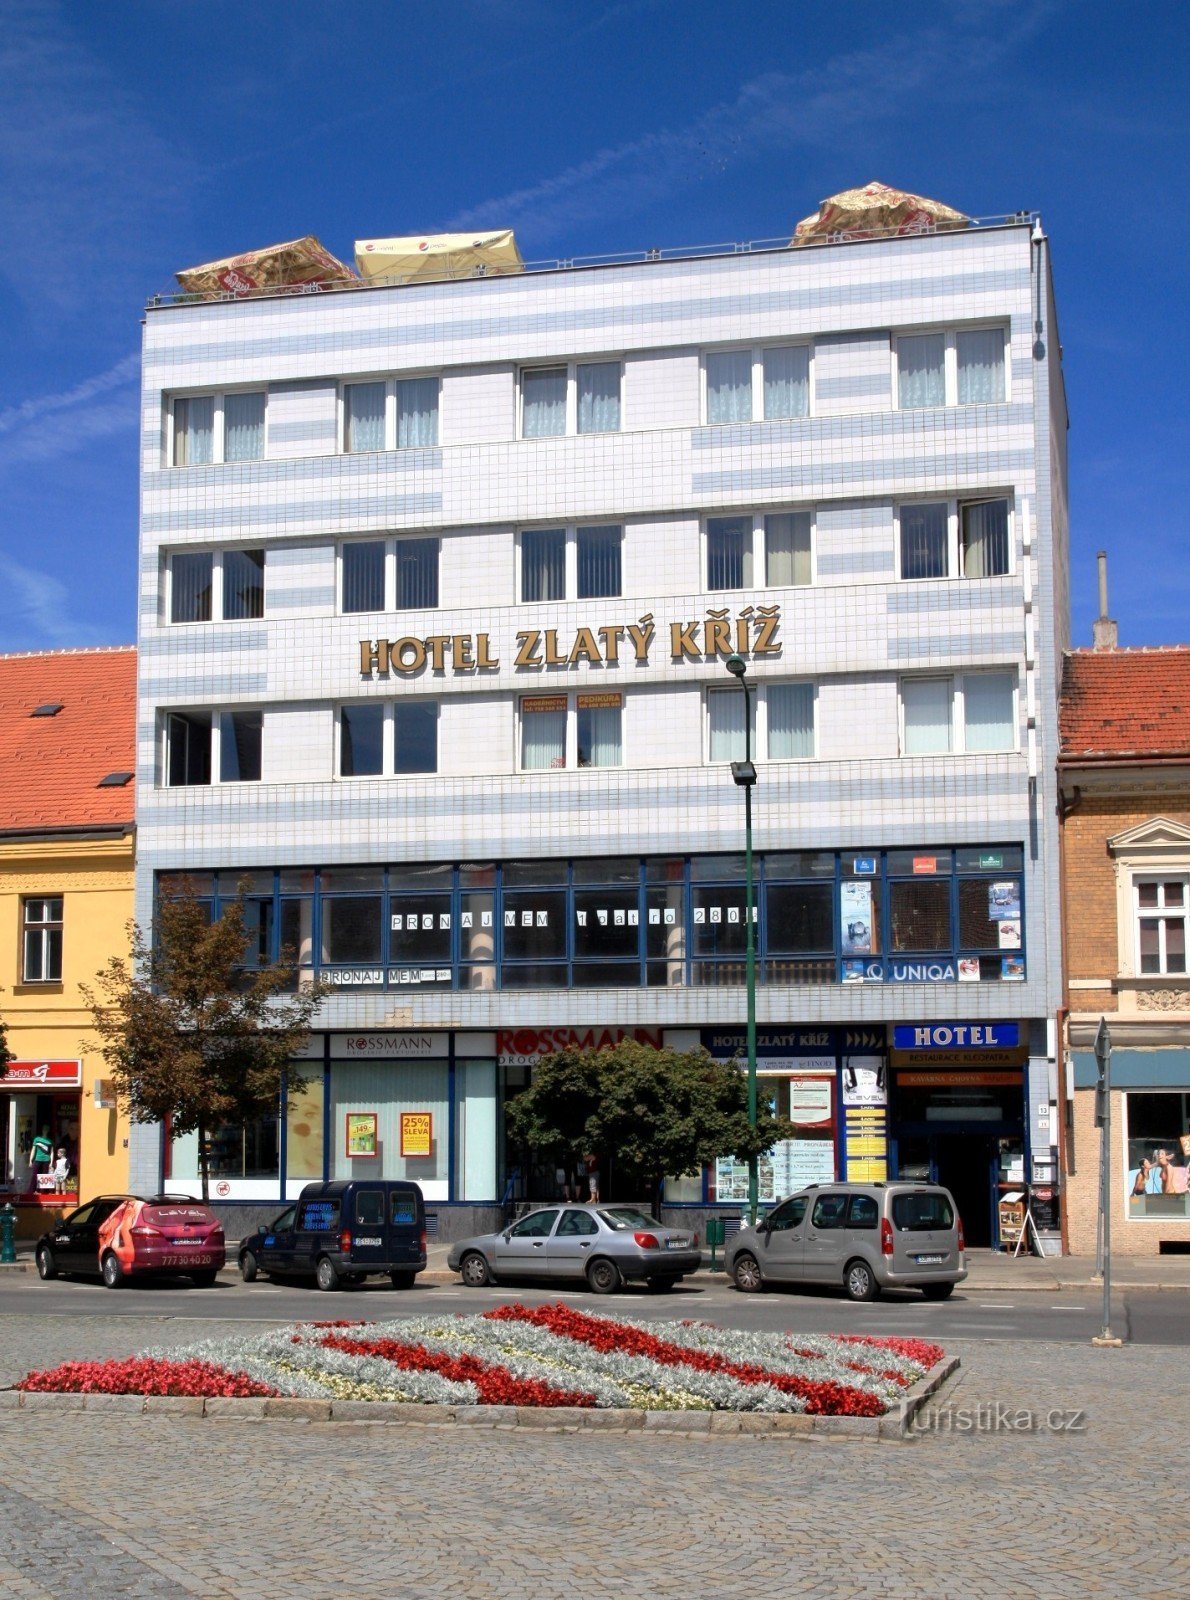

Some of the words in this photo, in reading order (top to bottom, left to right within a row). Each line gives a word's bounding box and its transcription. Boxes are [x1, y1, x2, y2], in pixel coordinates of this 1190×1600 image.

[359, 633, 499, 674] HOTEL
[514, 613, 655, 667] ZLATÝ
[669, 604, 783, 659] KŘÍŽ
[893, 965, 955, 981] UNIQA
[757, 1032, 795, 1047] ZLATÝ
[799, 1032, 830, 1046] KŘÍŽ
[914, 1026, 999, 1046] HOTEL
[347, 1037, 432, 1050] ROSSMANN
[499, 1055, 538, 1064] DROG
[964, 1053, 1010, 1061] KLEOPATRA
[403, 1117, 429, 1128] 25%
[162, 1255, 177, 1265] 777
[178, 1255, 188, 1265] 30
[189, 1255, 200, 1264] 40
[201, 1255, 212, 1264] 20
